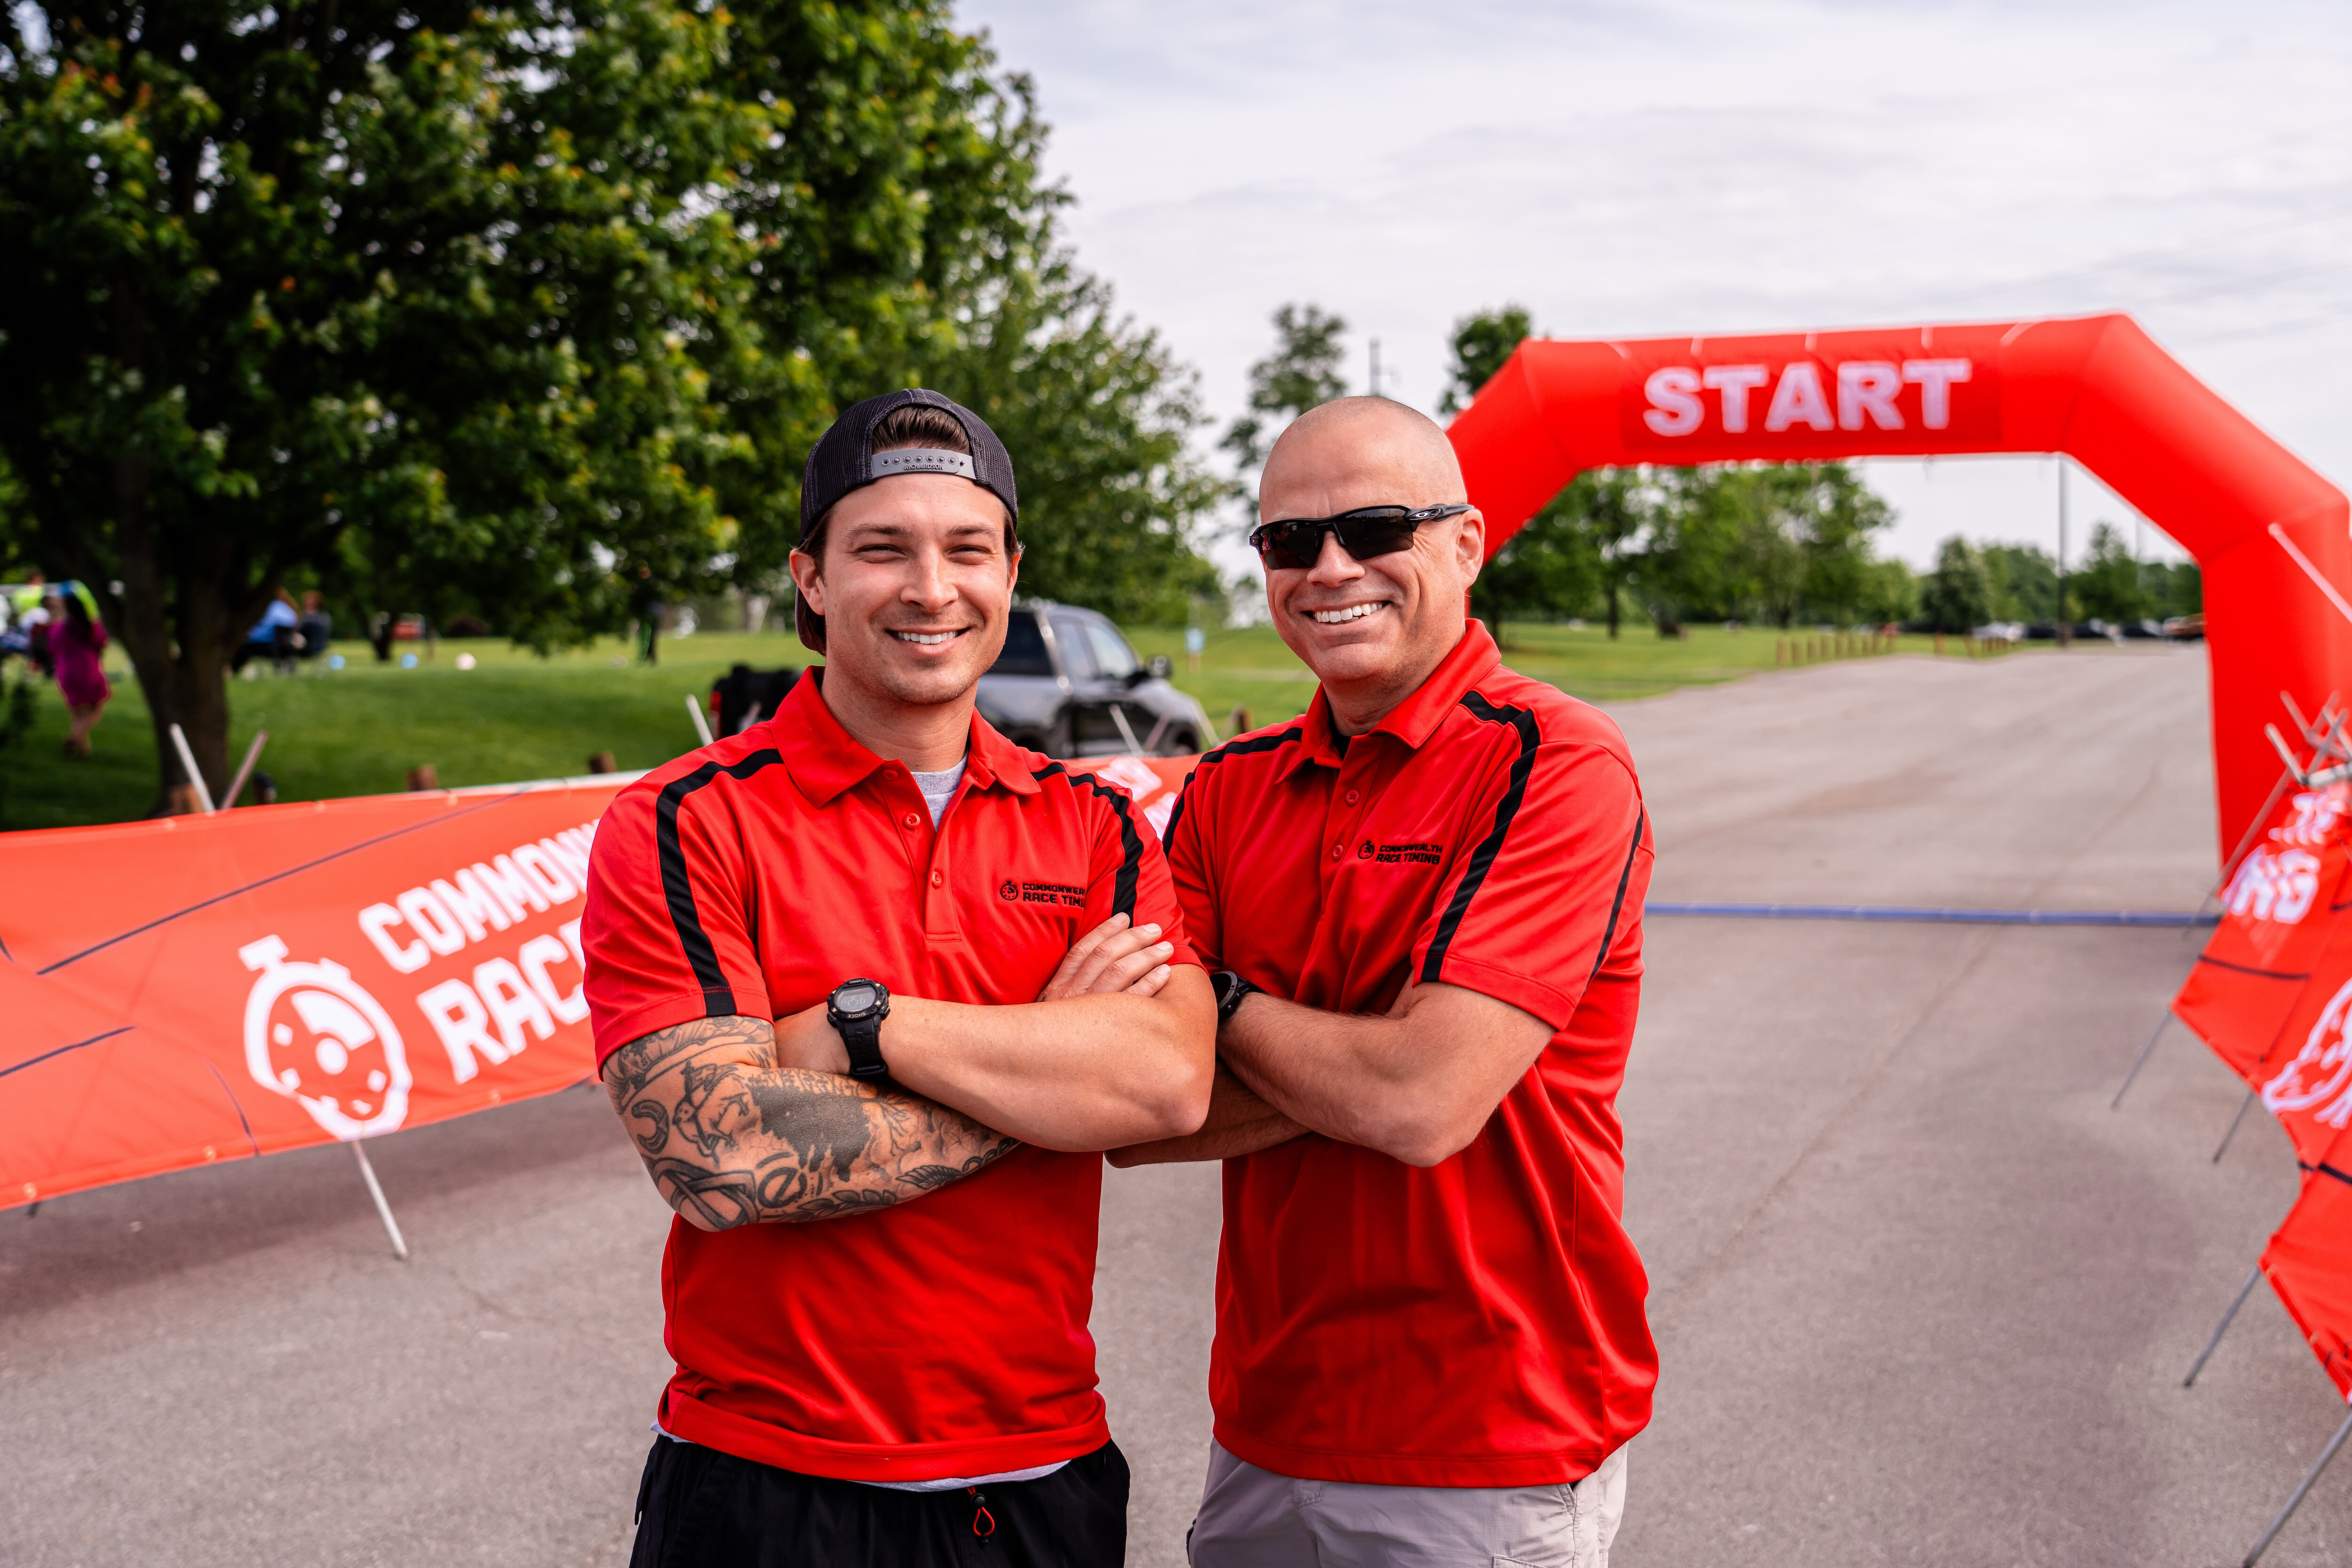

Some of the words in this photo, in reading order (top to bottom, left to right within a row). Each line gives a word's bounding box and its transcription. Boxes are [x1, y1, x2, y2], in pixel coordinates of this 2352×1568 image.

[1643, 358, 1972, 437] START
[1379, 844, 1443, 854] COMMONWEALTH
[1375, 853, 1401, 863] RACE
[1404, 853, 1440, 865] TIMING
[1023, 892, 1057, 903] RACE
